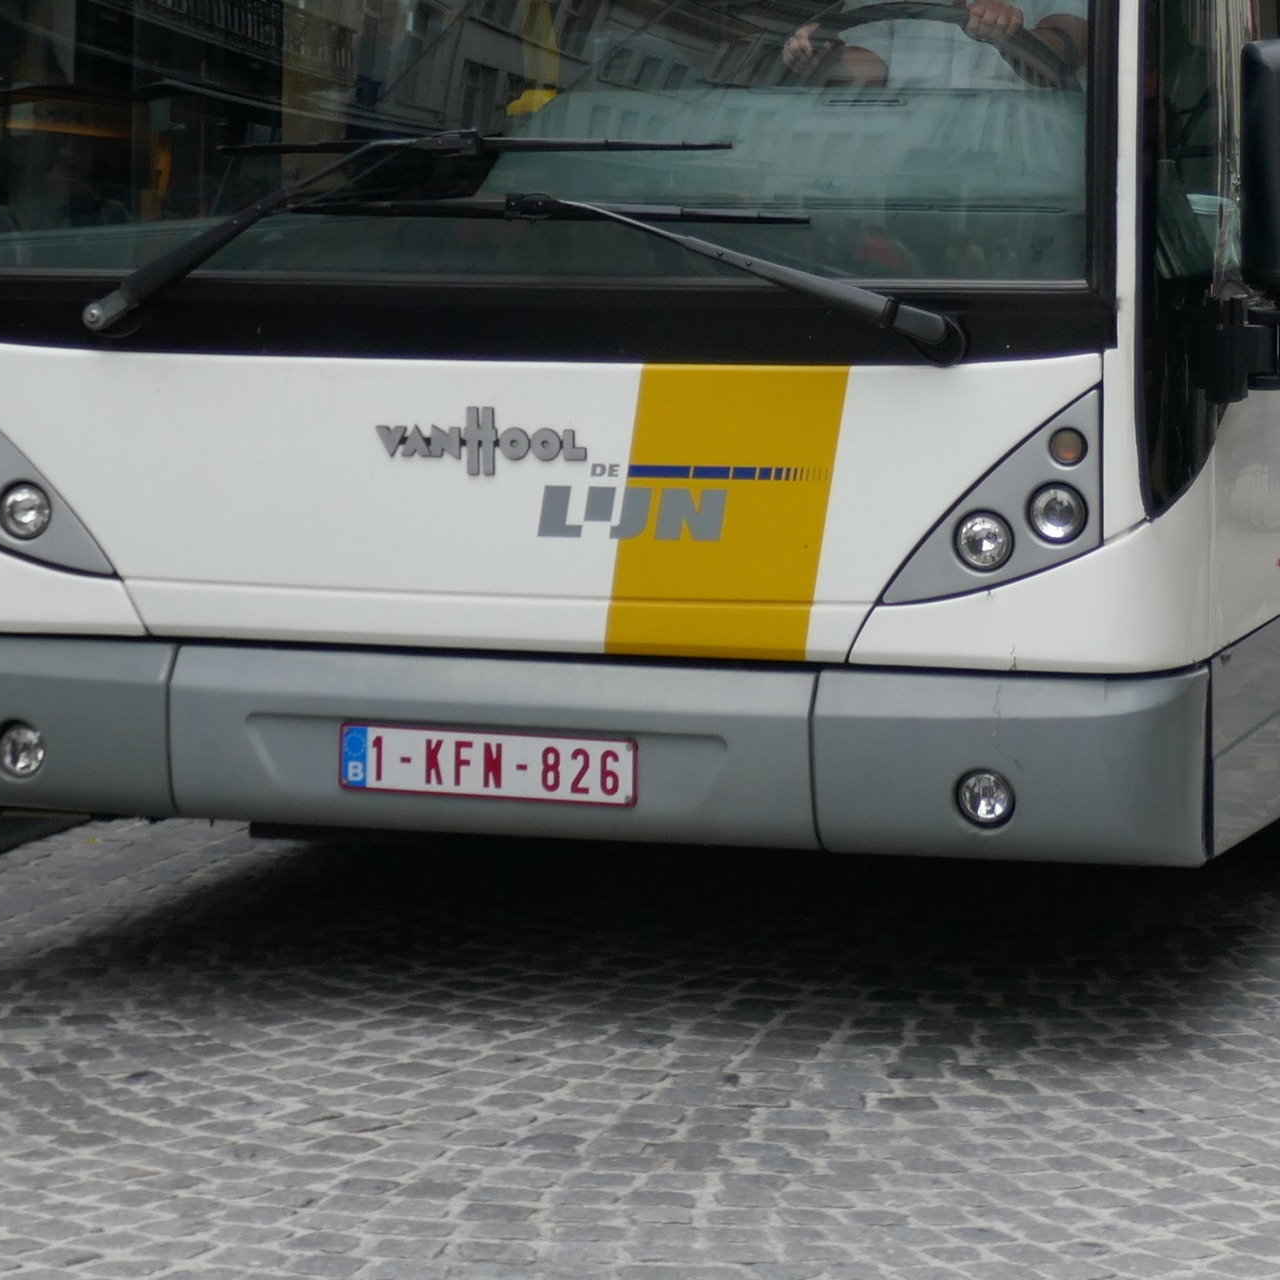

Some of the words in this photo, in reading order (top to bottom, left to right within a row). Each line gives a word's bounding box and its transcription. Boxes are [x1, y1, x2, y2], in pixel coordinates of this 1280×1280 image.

[590, 464, 619, 477] DE
[537, 485, 728, 541] LIJN
[348, 762, 363, 781] B
[371, 735, 621, 796] 1-KFN-826
